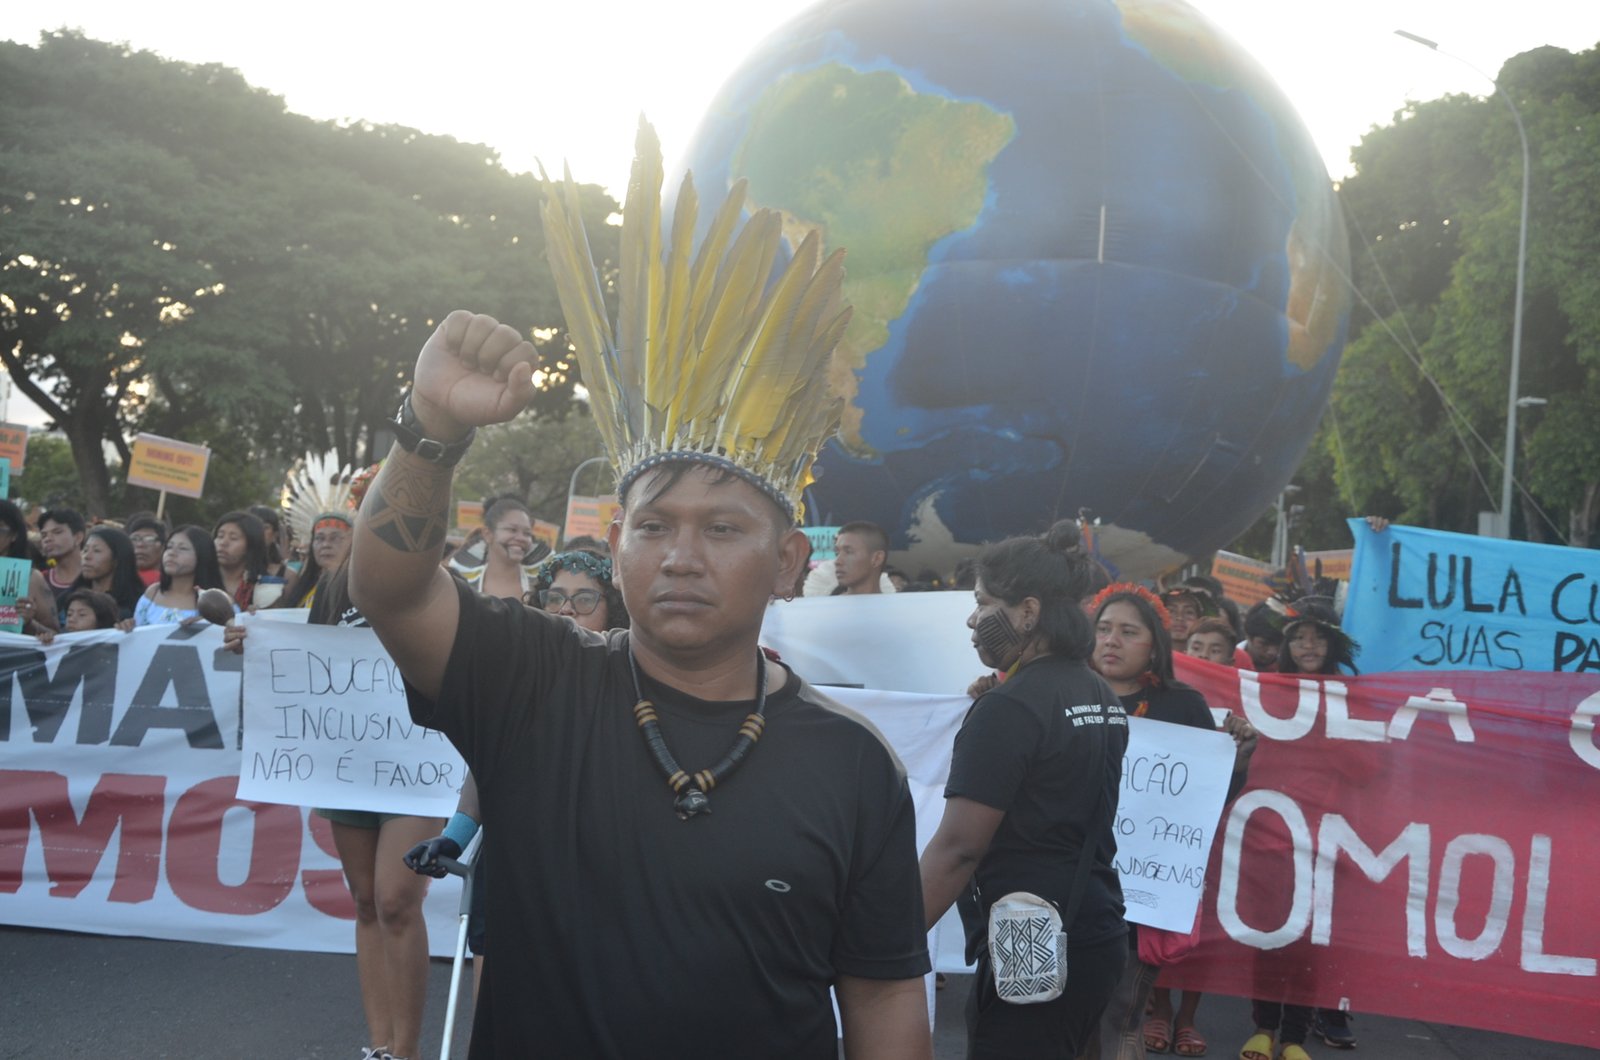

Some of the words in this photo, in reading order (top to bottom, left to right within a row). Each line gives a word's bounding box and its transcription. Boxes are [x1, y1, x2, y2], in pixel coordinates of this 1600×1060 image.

[1, 561, 21, 597] JÁ!
[1388, 542, 1526, 616] LULA
[1413, 621, 1524, 671] SUAS
[1065, 708, 1073, 717] A
[252, 747, 314, 783] NÃO
[336, 749, 354, 783] É
[1147, 816, 1203, 850] PARA
[1112, 854, 1204, 889] NDÍGENAS
[1217, 789, 1597, 977] OMOL
